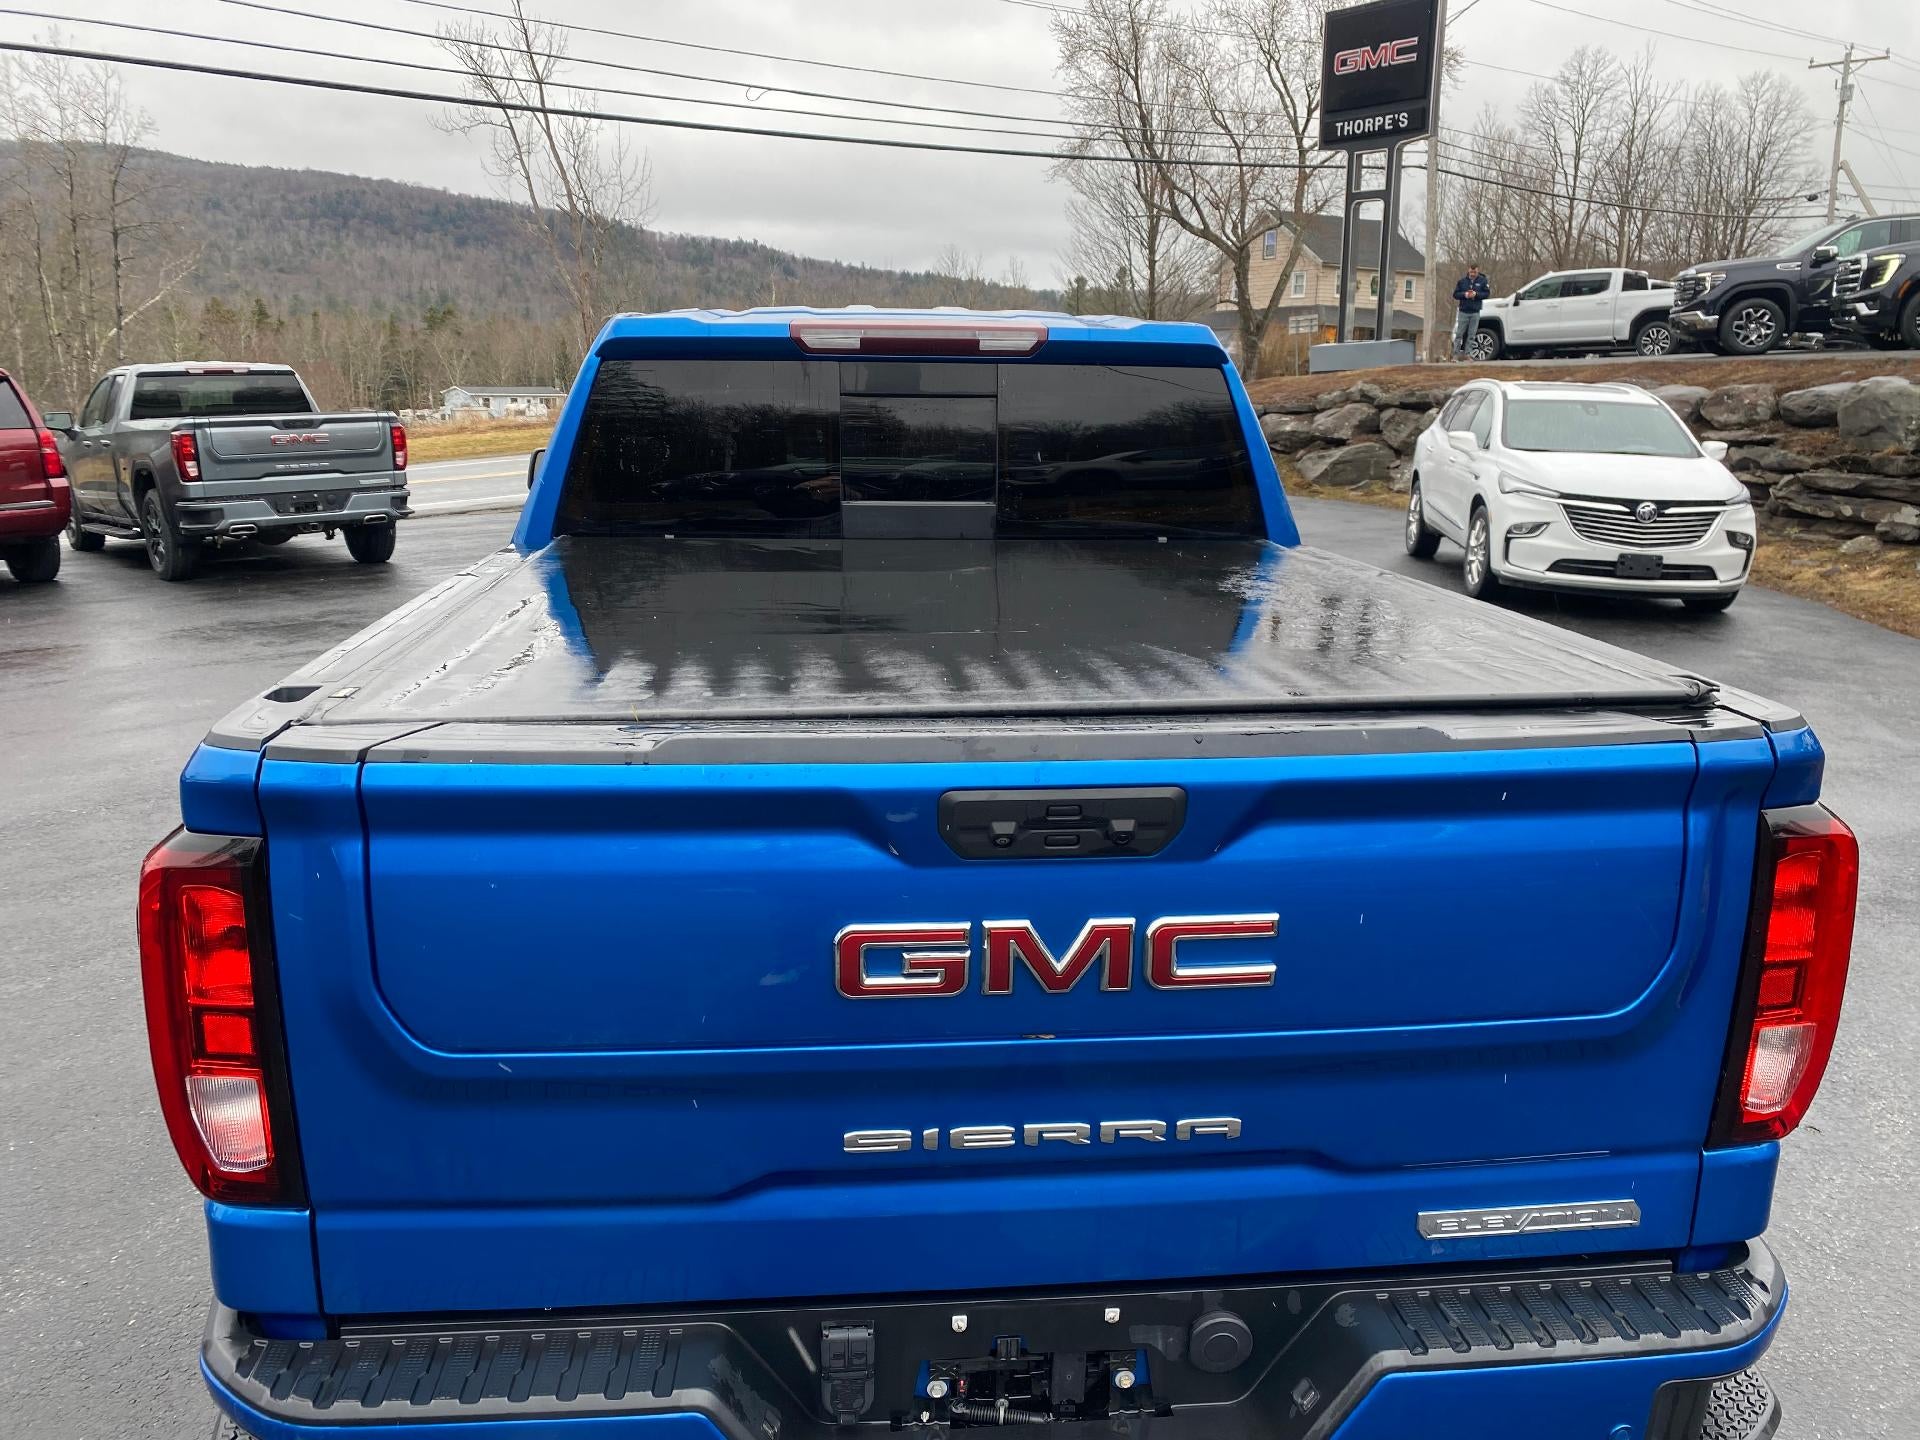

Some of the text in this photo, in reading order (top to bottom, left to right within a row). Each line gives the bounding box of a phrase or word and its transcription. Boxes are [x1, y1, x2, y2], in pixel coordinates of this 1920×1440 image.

[1334, 36, 1419, 76] GMC
[1335, 112, 1409, 137] THORPE'S
[270, 433, 330, 446] GMC
[834, 913, 1280, 999] GMC
[843, 1117, 1242, 1153] SIERRA
